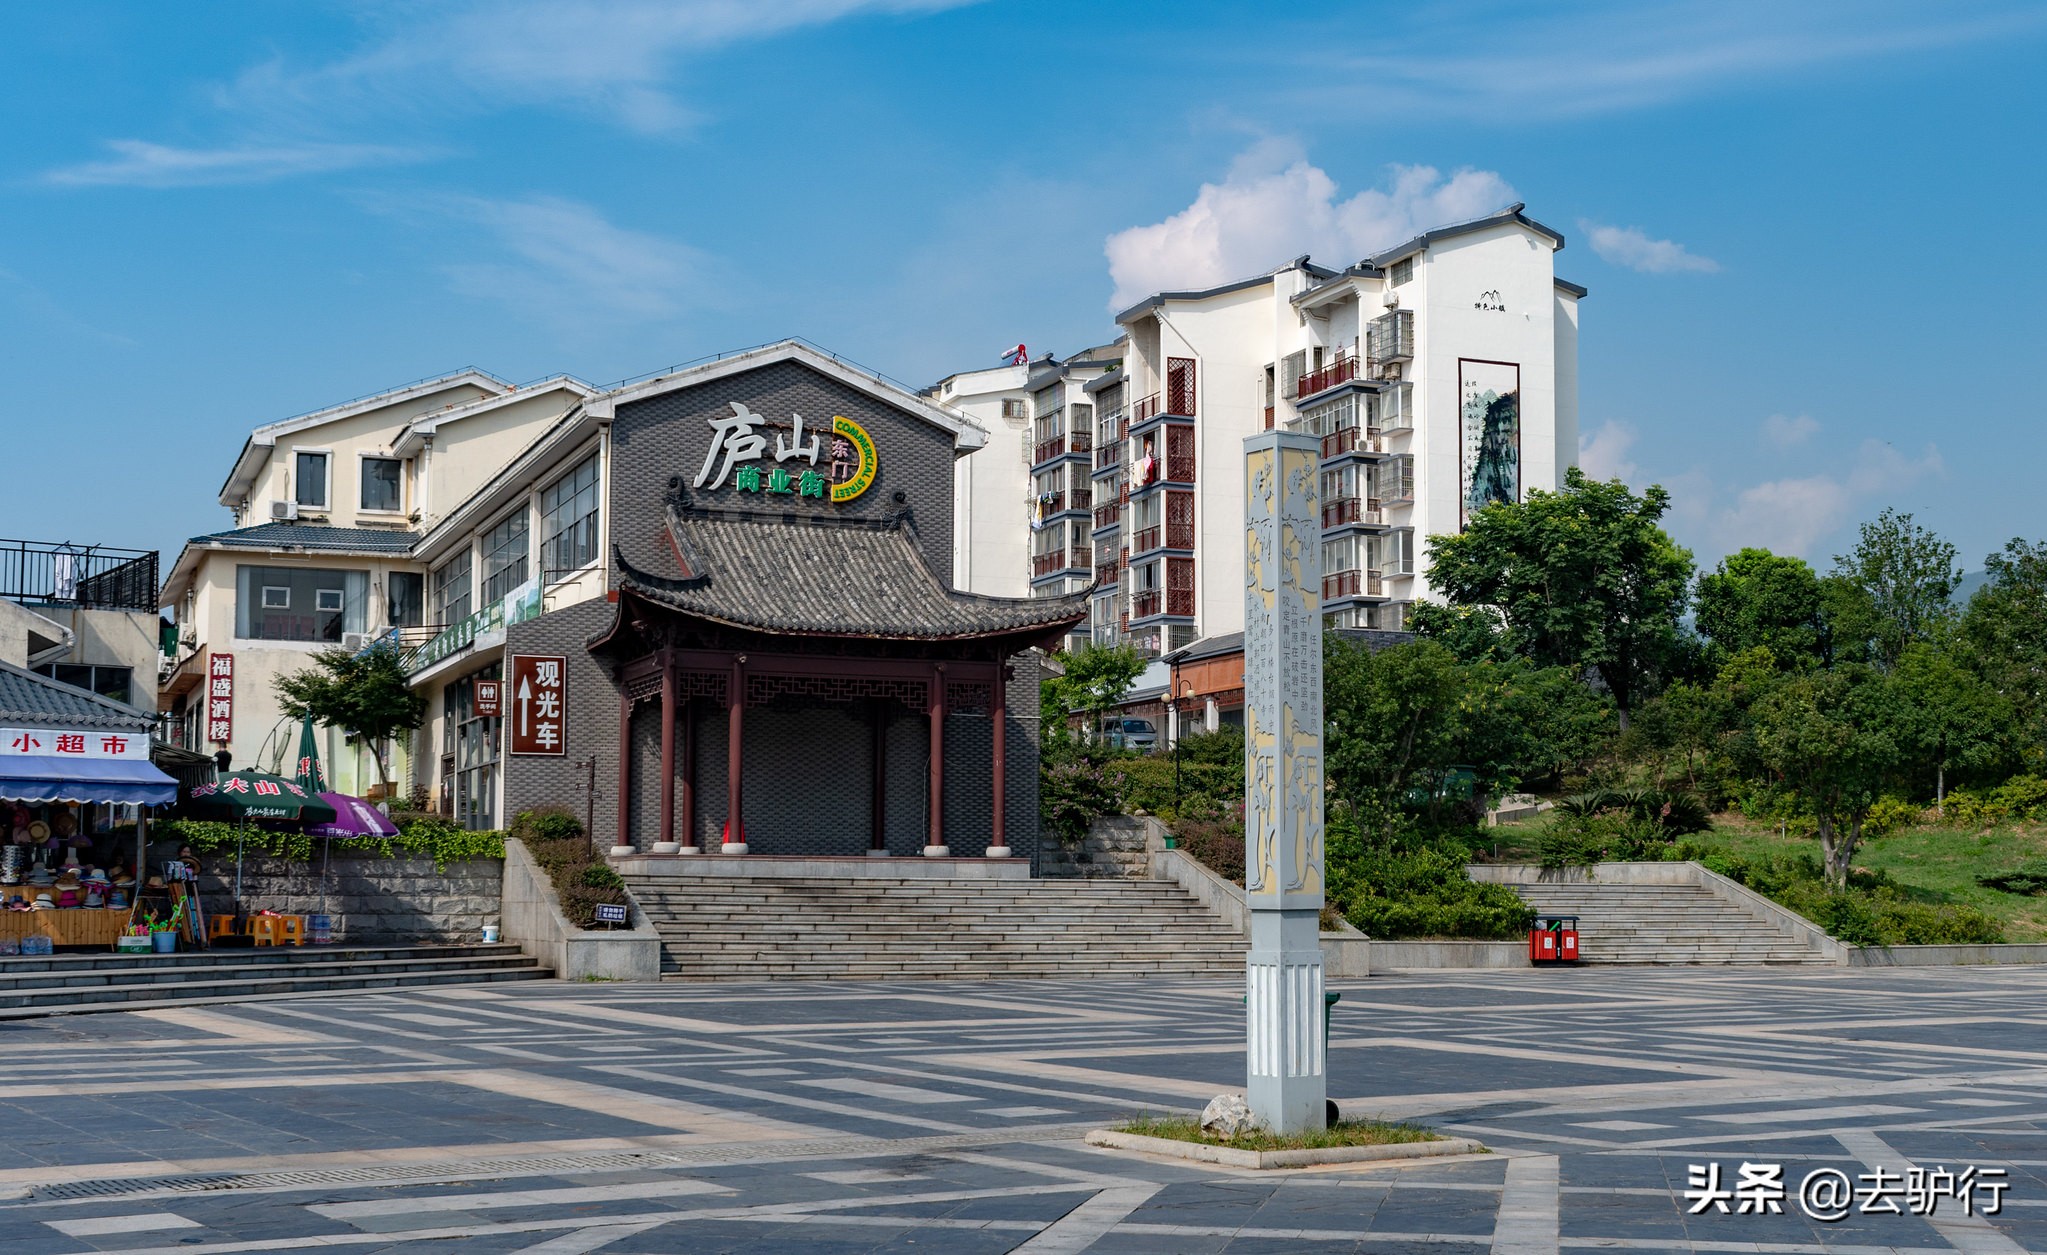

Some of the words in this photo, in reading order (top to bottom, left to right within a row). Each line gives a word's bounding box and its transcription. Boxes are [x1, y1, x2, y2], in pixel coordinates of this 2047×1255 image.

[693, 402, 821, 490] 庐山
[832, 439, 849, 479] 东门
[835, 420, 874, 478] COMMERCIAL
[736, 465, 825, 499] 商业街
[834, 477, 867, 499] STREET
[210, 656, 232, 740] 福盛酒楼
[535, 661, 560, 749] 观光车
[12, 733, 128, 755] 小超市
